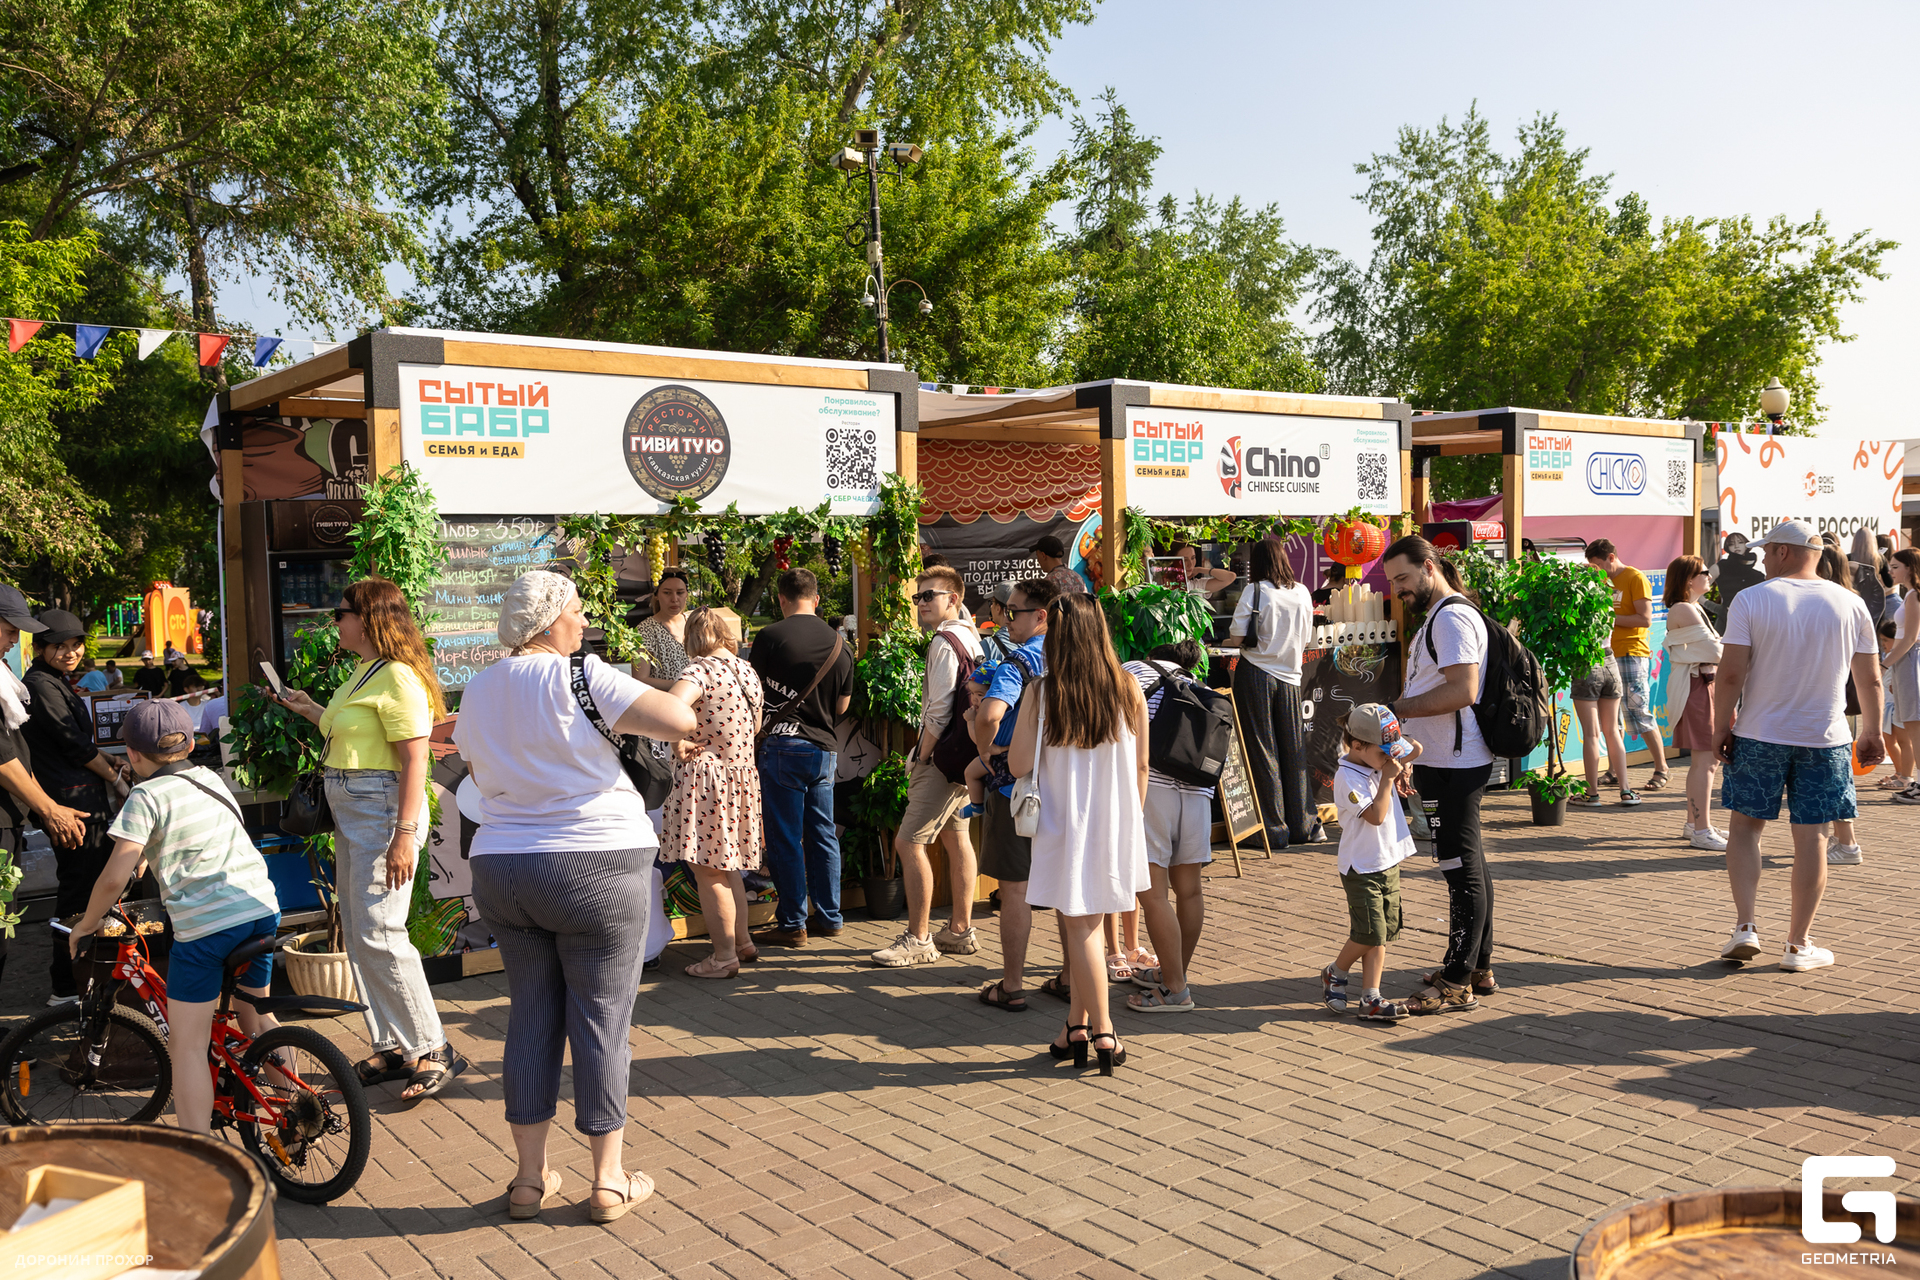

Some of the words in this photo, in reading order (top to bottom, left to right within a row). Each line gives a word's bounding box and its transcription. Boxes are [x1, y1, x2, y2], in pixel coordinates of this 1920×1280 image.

[419, 379, 549, 408] СЫТЫЙ
[824, 396, 877, 407] Понравилось
[647, 408, 707, 433] РЕСТОРАН
[818, 406, 881, 417] обслуживание?
[420, 404, 550, 438] БАБР
[1133, 420, 1203, 440] СЫТЫЙ
[428, 444, 475, 455] СЕМЬЯ
[480, 447, 488, 455] и
[492, 446, 519, 457] ЕДА
[629, 435, 680, 453] ГИВИ
[1133, 438, 1203, 463] БАБР
[1529, 435, 1572, 451] СЫТЫЙ
[1245, 446, 1321, 479] Chino
[1530, 450, 1572, 469] БАБР
[647, 456, 690, 482] кавказская
[691, 457, 709, 478] кухня
[1137, 467, 1163, 476] СЕМЬЯ
[1171, 469, 1187, 478] ЕДА
[1552, 473, 1562, 481] ЕДА
[1589, 457, 1645, 491] CHICKO
[1247, 480, 1285, 493] CHINESE
[1286, 482, 1320, 494] CUISINE
[1817, 475, 1835, 484] ФОКС
[1817, 485, 1836, 493] PIZZA
[593, 718, 626, 748] MICKEY
[1430, 816, 1441, 828] 95
[145, 1000, 170, 1042] STE
